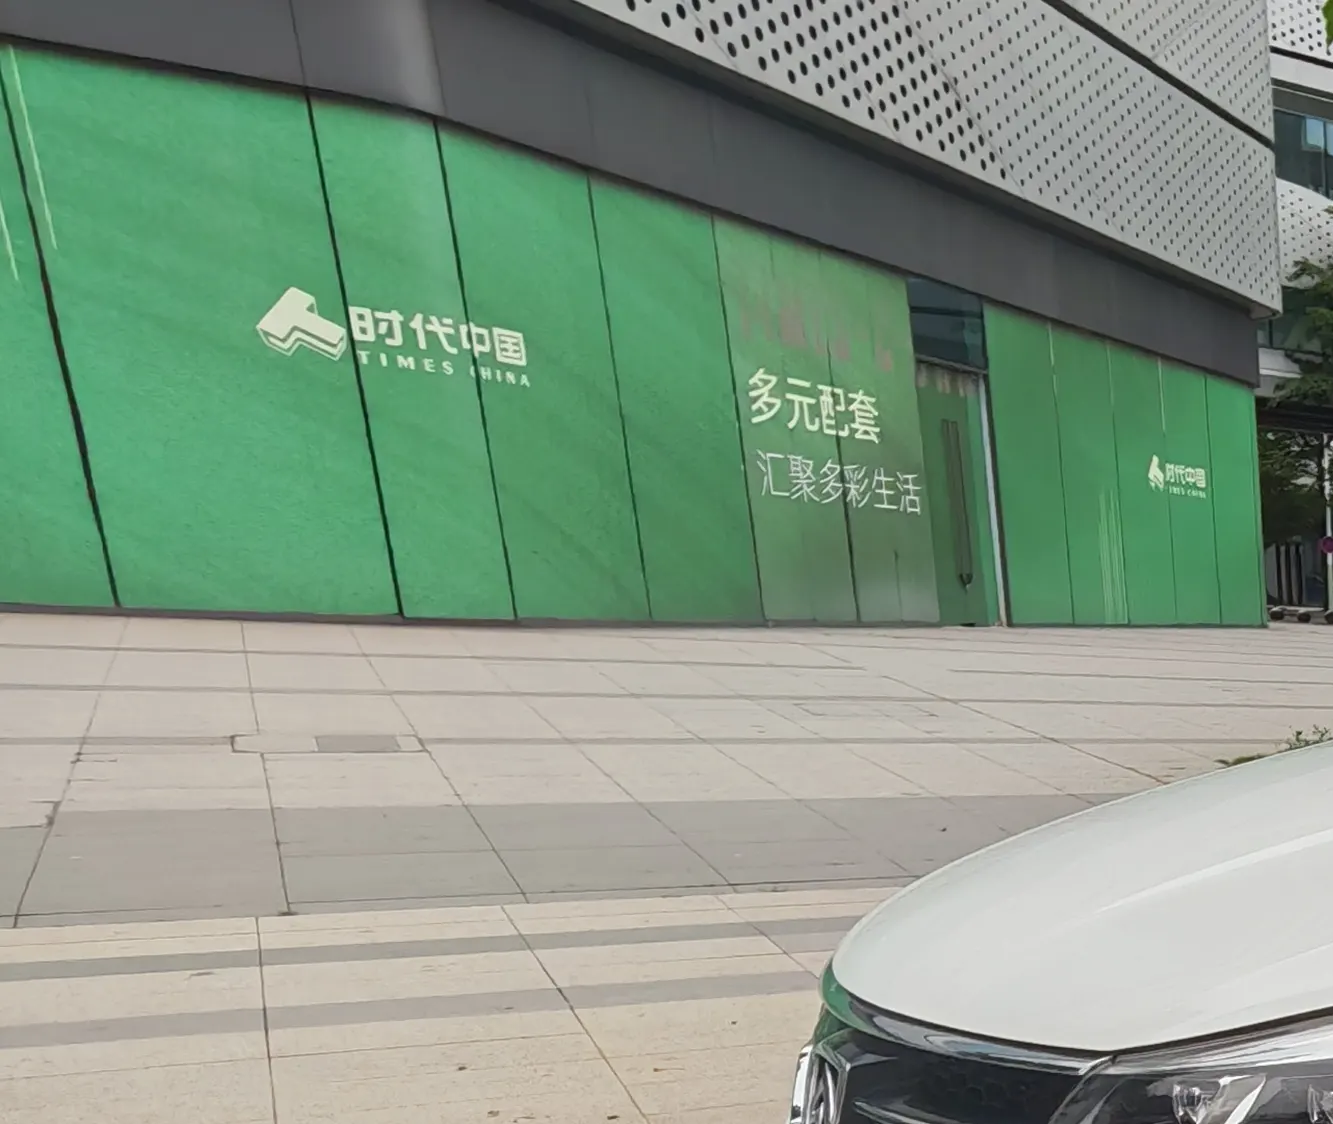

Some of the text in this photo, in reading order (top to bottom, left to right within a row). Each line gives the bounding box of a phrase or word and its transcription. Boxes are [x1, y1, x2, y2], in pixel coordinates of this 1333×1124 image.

[348, 306, 527, 366] 时代中国
[357, 351, 454, 375] TIMES
[748, 368, 880, 444] 多元配套
[757, 449, 922, 515] 汇聚多彩生活
